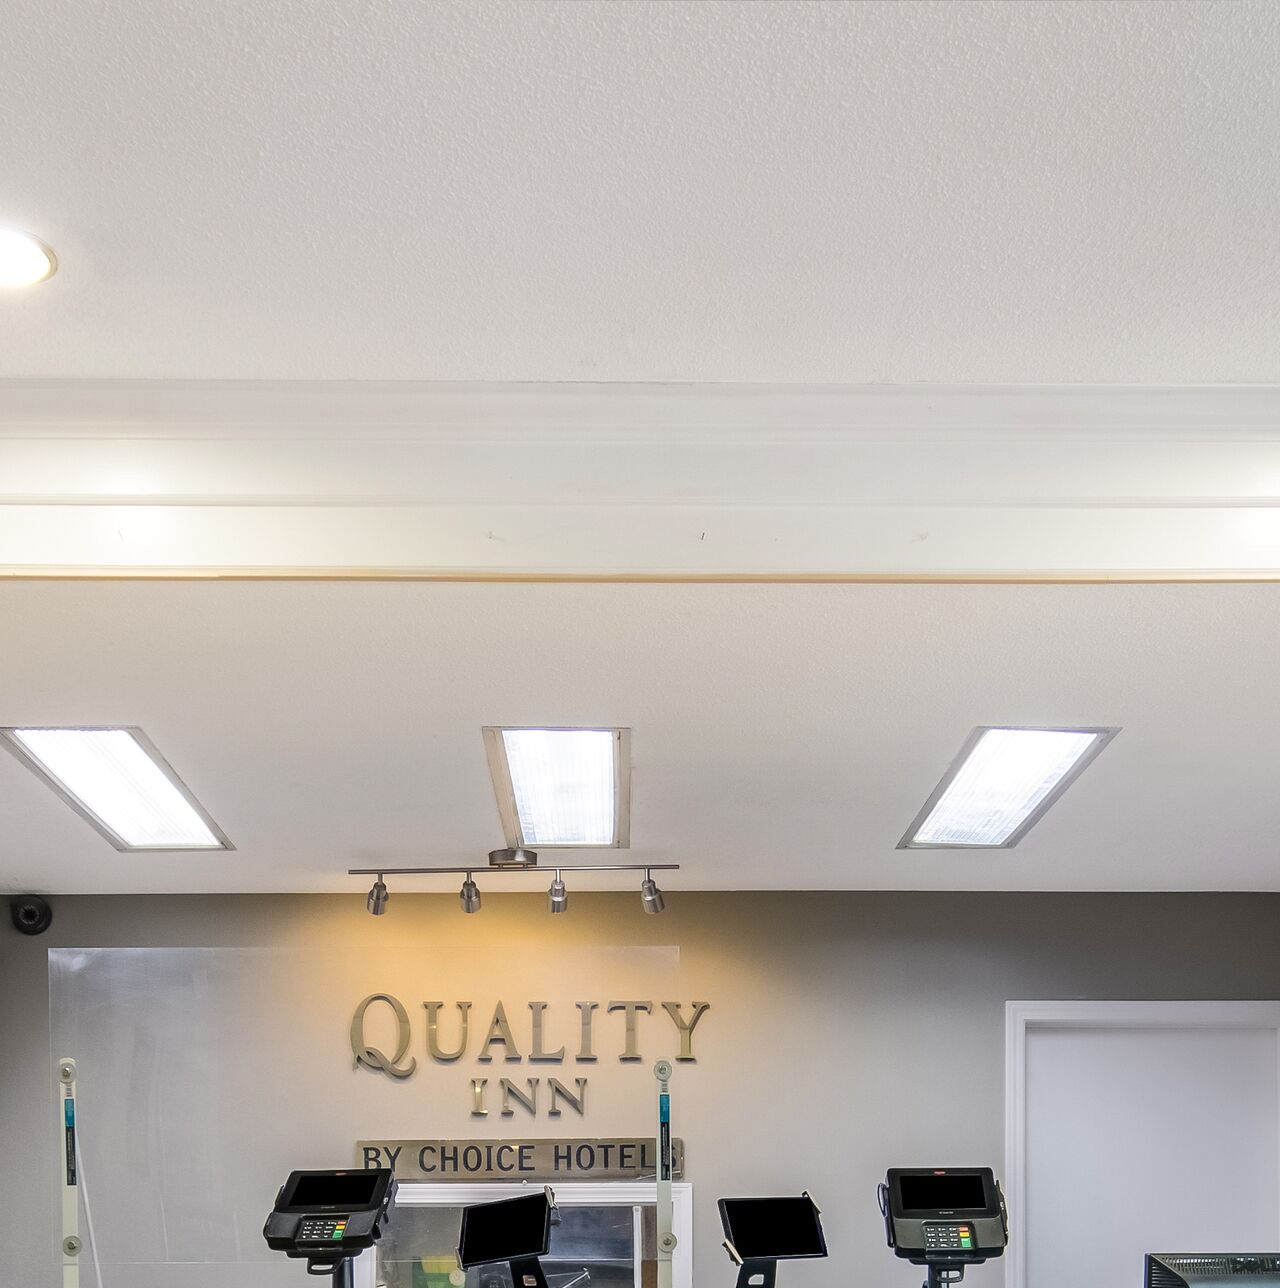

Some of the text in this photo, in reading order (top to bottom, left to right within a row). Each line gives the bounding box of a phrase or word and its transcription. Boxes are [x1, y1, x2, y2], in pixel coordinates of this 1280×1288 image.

[350, 992, 710, 1077] QUALITY
[472, 1077, 587, 1116] INN
[363, 1144, 677, 1172] BY CHOICE HOTEL
